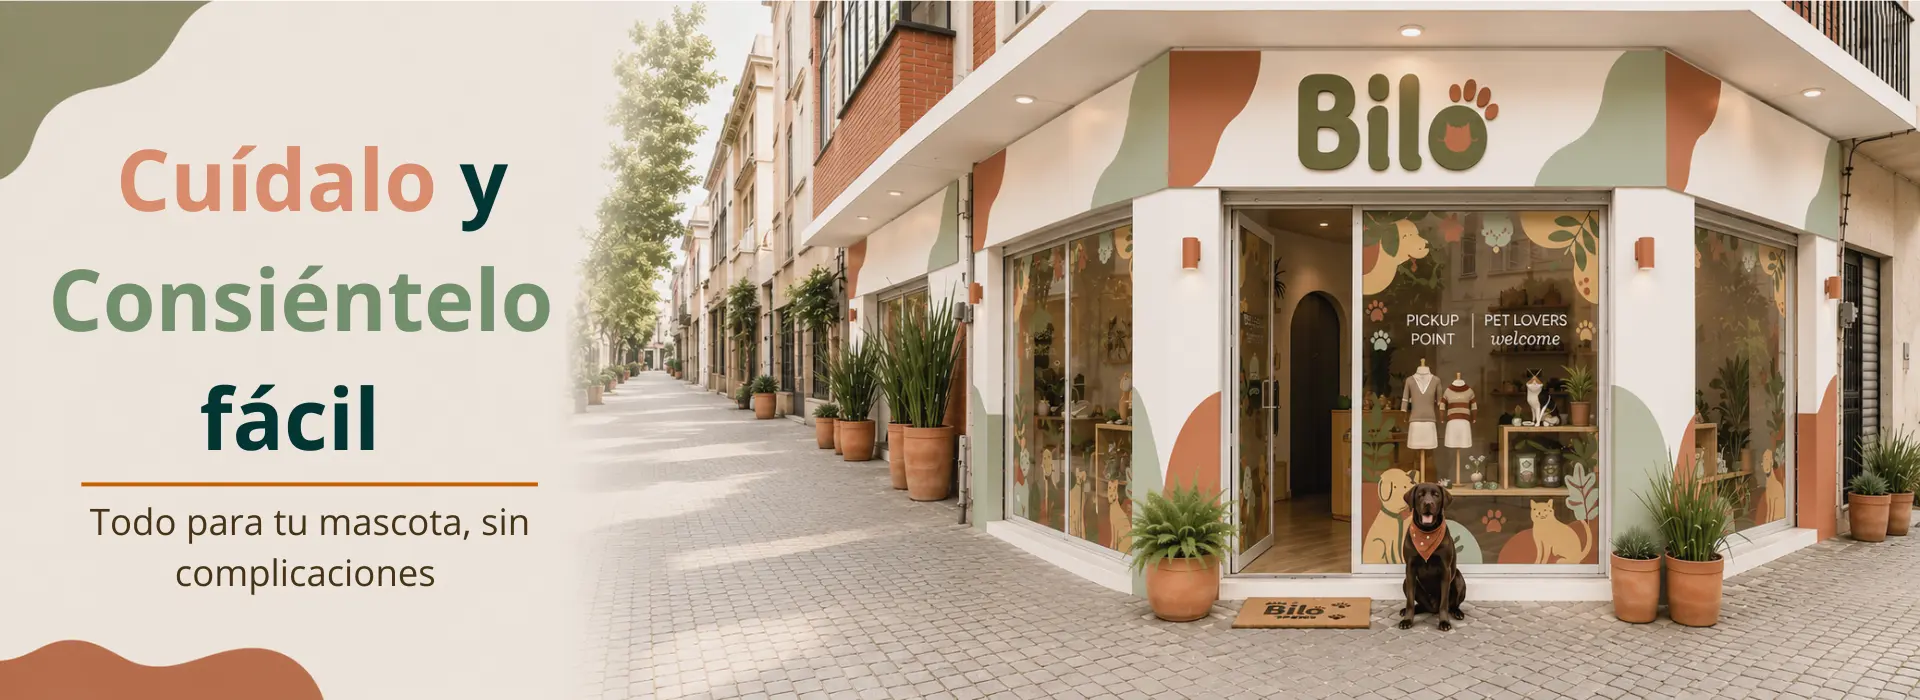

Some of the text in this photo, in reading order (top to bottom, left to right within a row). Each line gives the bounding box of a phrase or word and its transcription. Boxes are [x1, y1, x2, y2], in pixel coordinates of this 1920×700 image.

[1298, 73, 1492, 171] Bilo
[1407, 314, 1459, 326] PICKUP
[1484, 314, 1567, 326] PET LOVERS
[1411, 333, 1455, 345] POINT
[1490, 331, 1560, 345] welcome
[1263, 603, 1325, 615] Bilo
